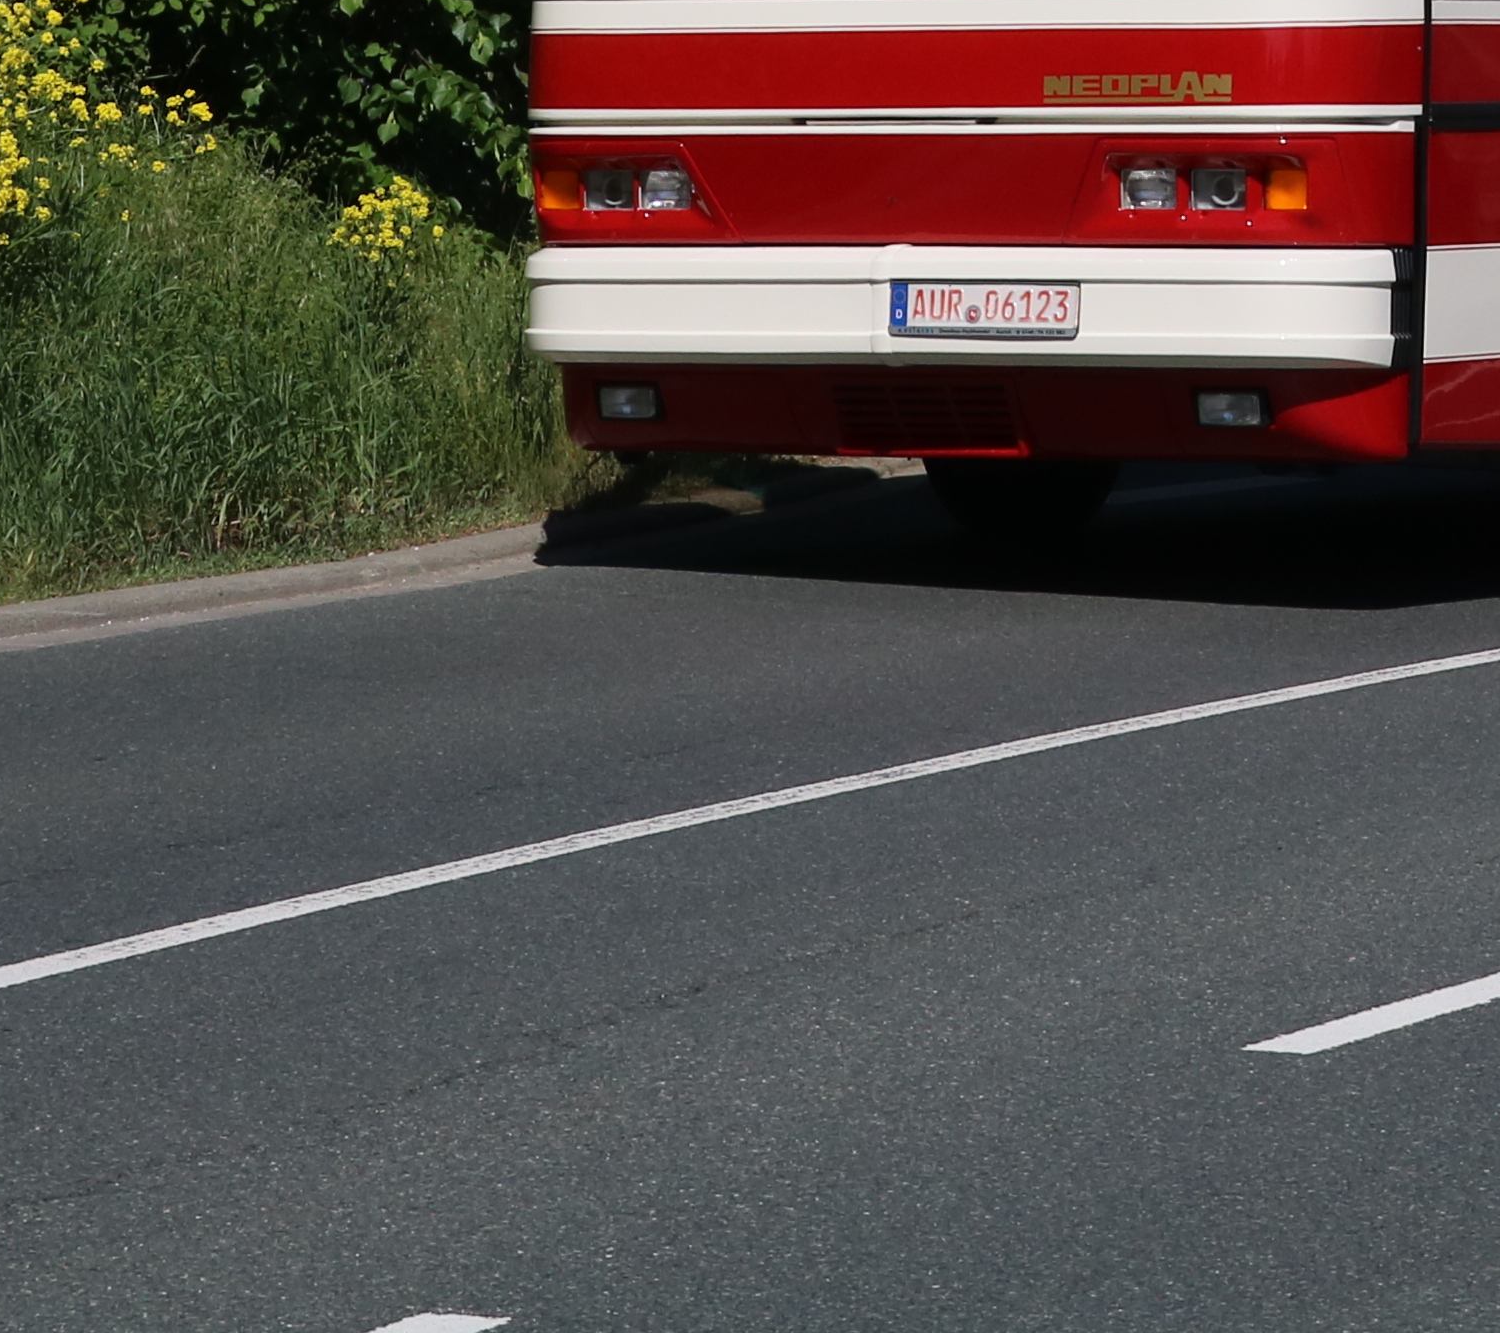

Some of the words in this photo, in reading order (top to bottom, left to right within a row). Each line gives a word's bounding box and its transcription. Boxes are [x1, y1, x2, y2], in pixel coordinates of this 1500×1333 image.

[1043, 71, 1232, 103] NEOPLAN
[895, 308, 903, 319] D
[912, 288, 963, 321] AUR
[984, 289, 1071, 323] 06123
